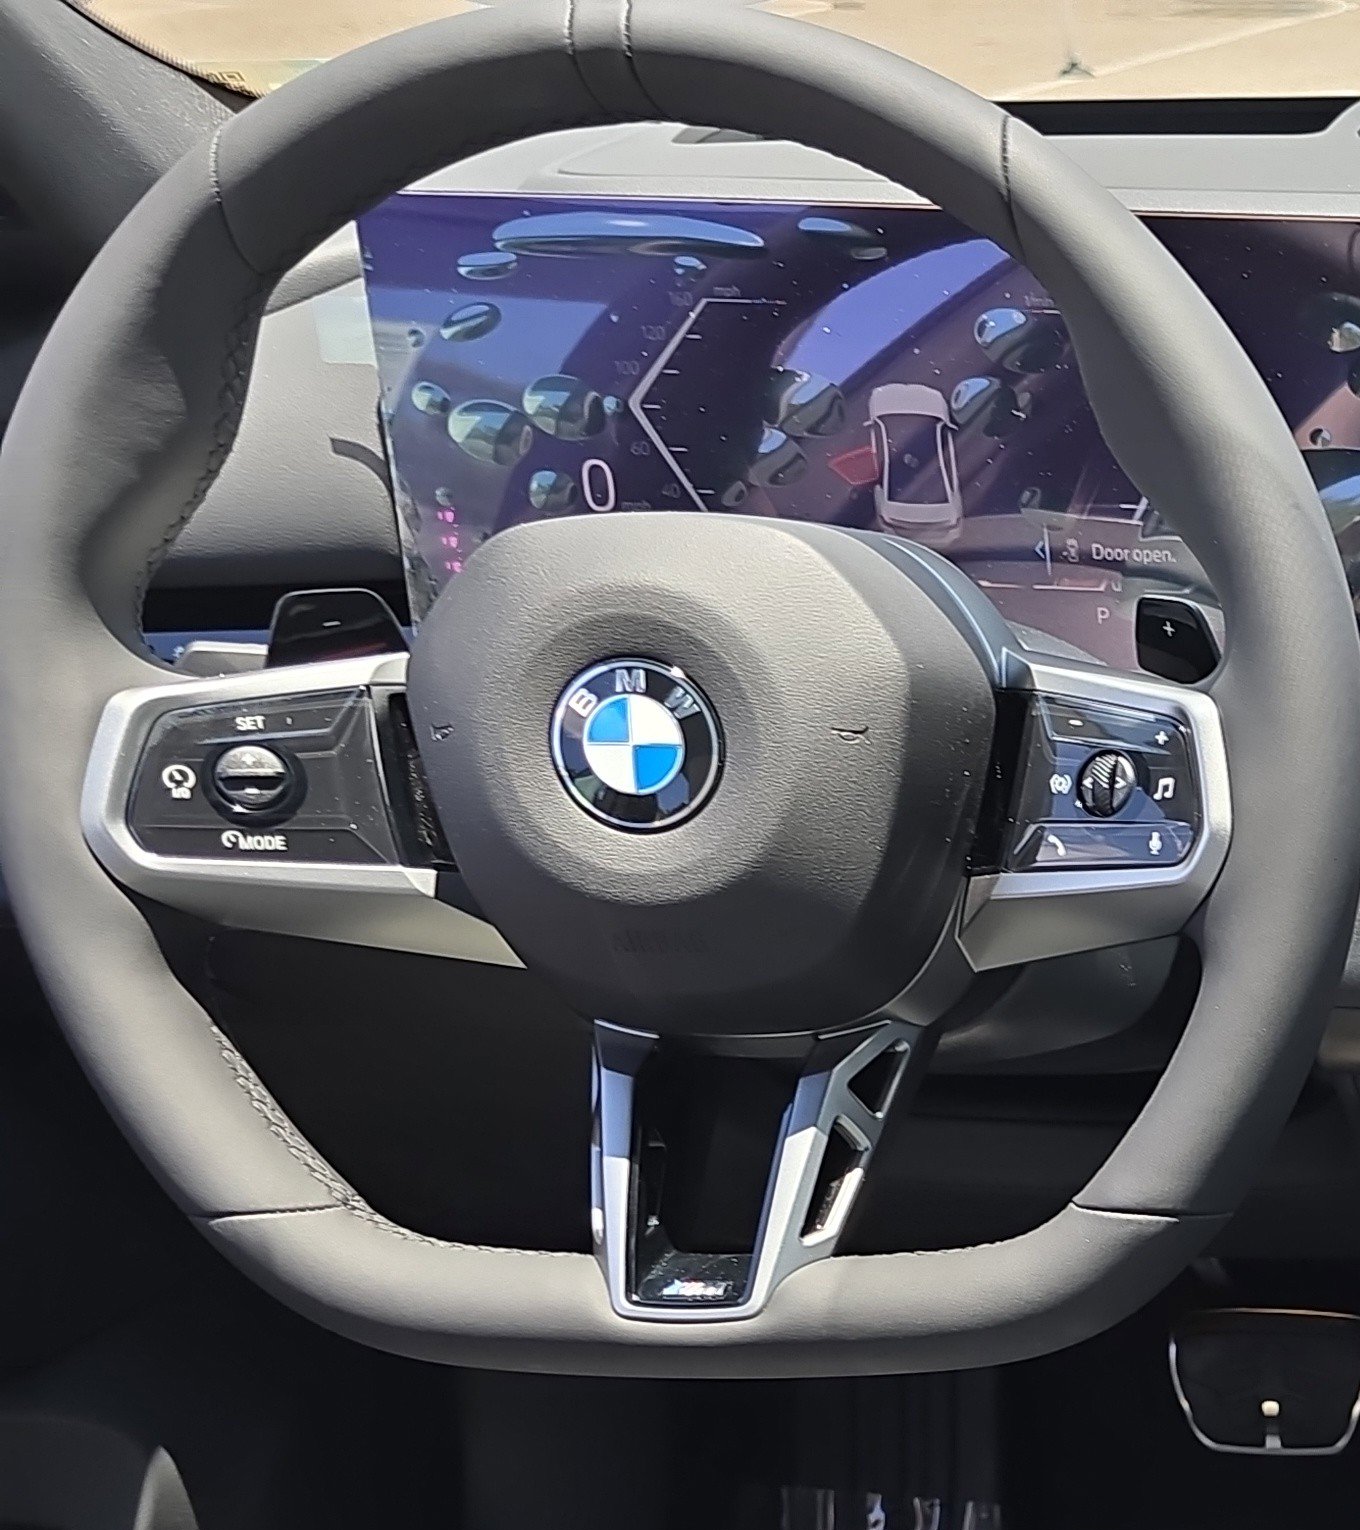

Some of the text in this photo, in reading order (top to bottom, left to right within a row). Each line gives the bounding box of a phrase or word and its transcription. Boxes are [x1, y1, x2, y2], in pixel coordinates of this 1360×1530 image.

[581, 458, 616, 512] 0
[1091, 543, 1177, 564] Door open.
[1097, 606, 1110, 624] P
[568, 668, 702, 720] BMW
[235, 715, 266, 731] SET
[239, 834, 288, 851] MODE
